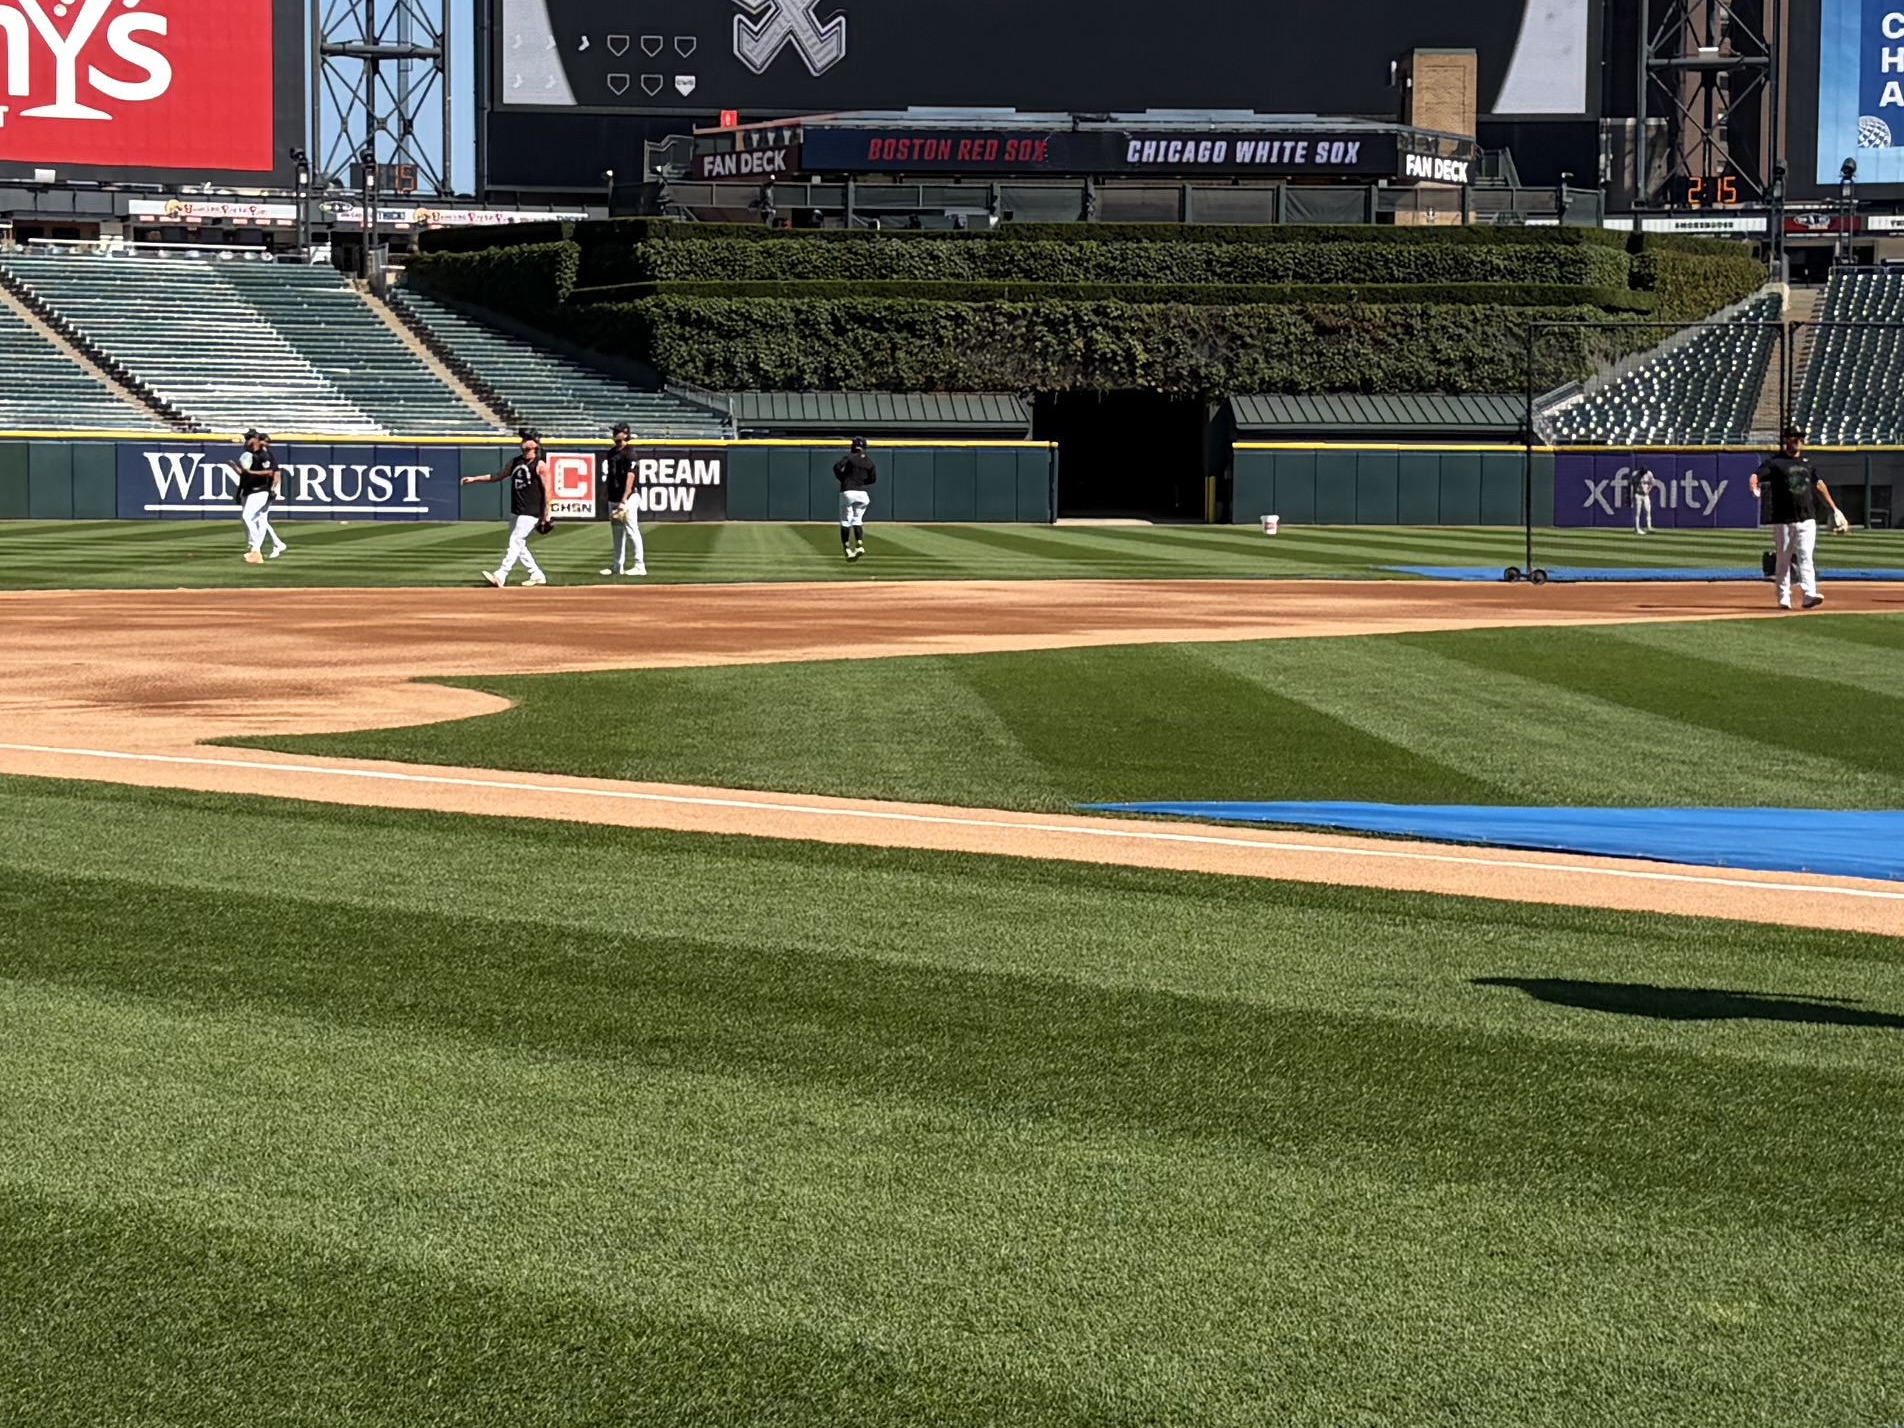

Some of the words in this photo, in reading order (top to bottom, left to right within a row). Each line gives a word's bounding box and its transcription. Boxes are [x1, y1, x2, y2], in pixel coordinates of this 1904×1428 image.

[703, 153, 737, 176] FAN
[740, 149, 786, 173] DECK
[867, 137, 947, 161] BOSTON
[957, 139, 997, 161] RED
[1004, 139, 1047, 161] SOX
[1127, 140, 1227, 163] CHICAGO
[1235, 140, 1306, 164] WHITE
[1314, 141, 1361, 164] SOX
[1406, 154, 1433, 177] FAN
[1435, 160, 1468, 183] DECK
[1688, 176, 1737, 204] 2:15
[602, 459, 720, 485] REAM
[1583, 466, 1728, 515] xfnity
